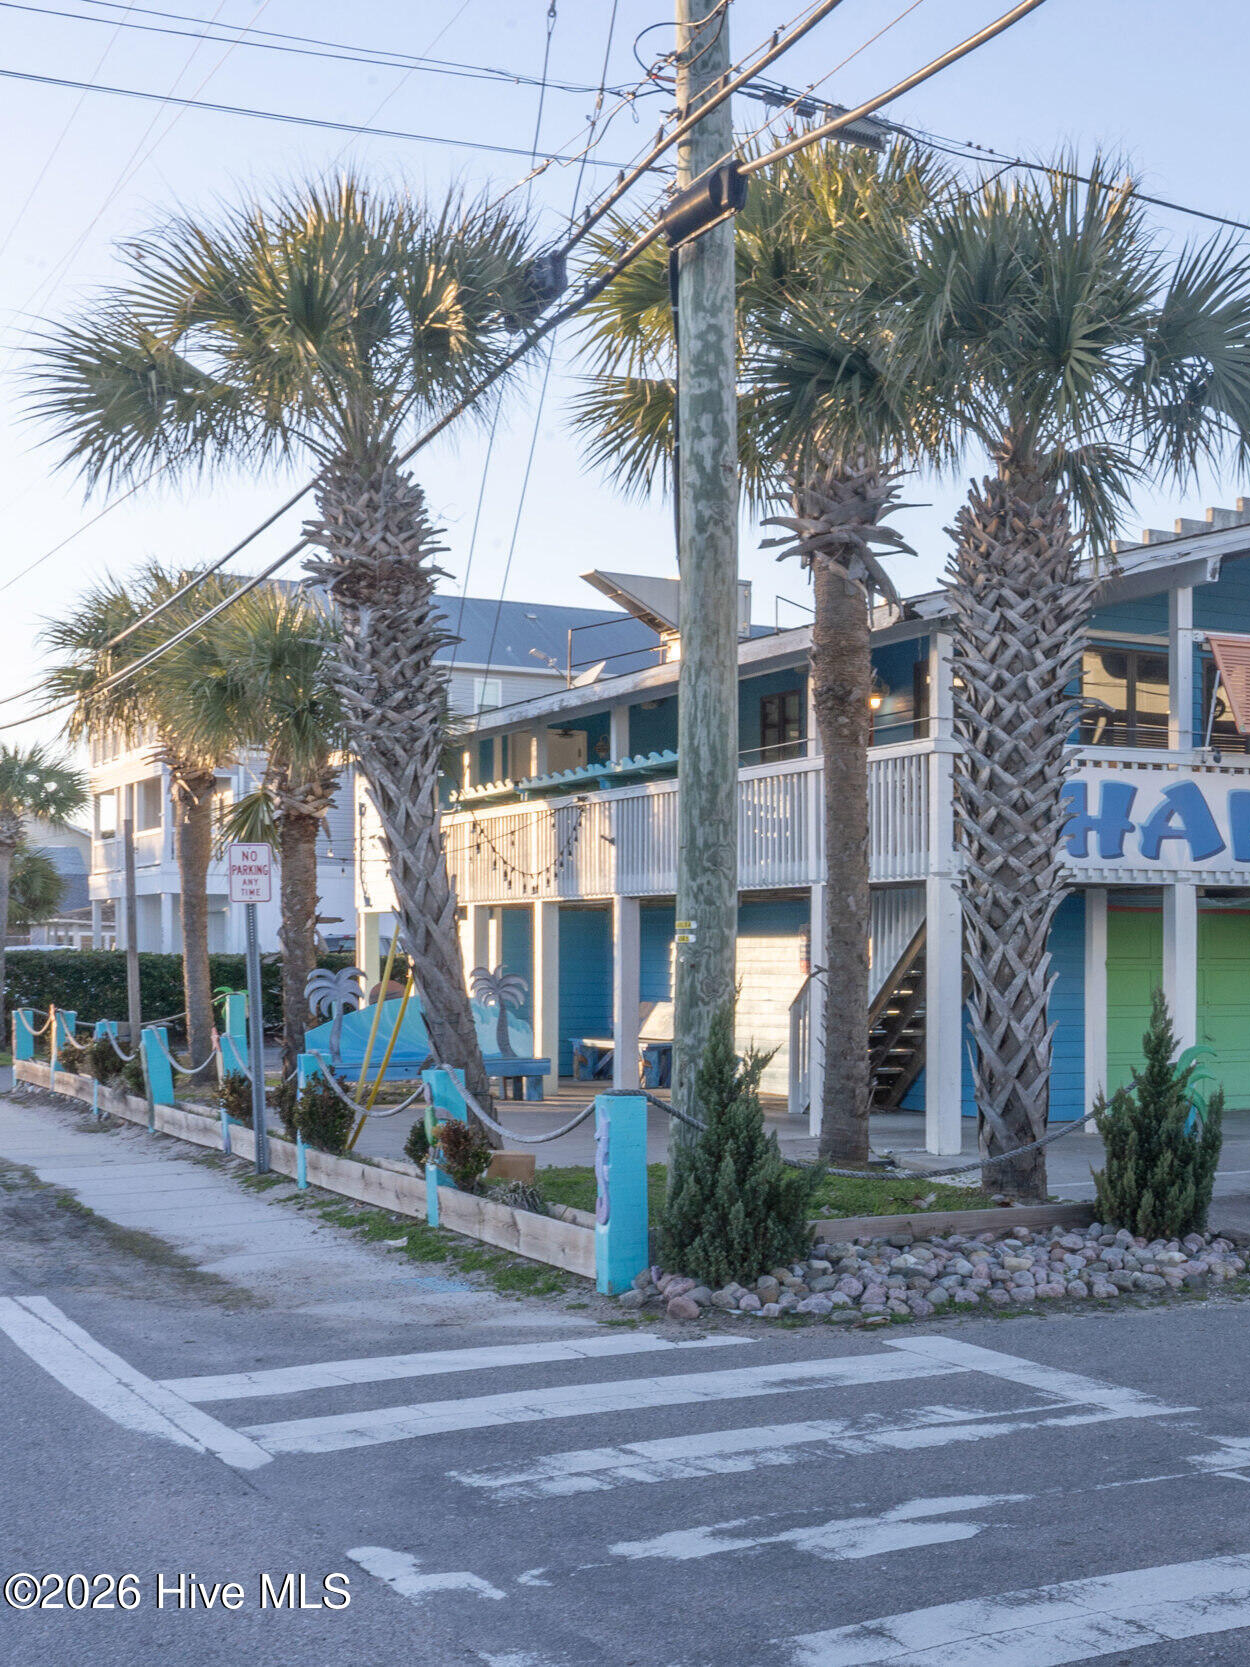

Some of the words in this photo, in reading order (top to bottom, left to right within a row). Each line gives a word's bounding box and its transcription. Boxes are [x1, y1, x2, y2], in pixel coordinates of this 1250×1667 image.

[241, 850, 258, 862] NO
[231, 864, 270, 876] PARKING
[242, 878, 258, 886] ANY
[241, 888, 261, 896] TIME
